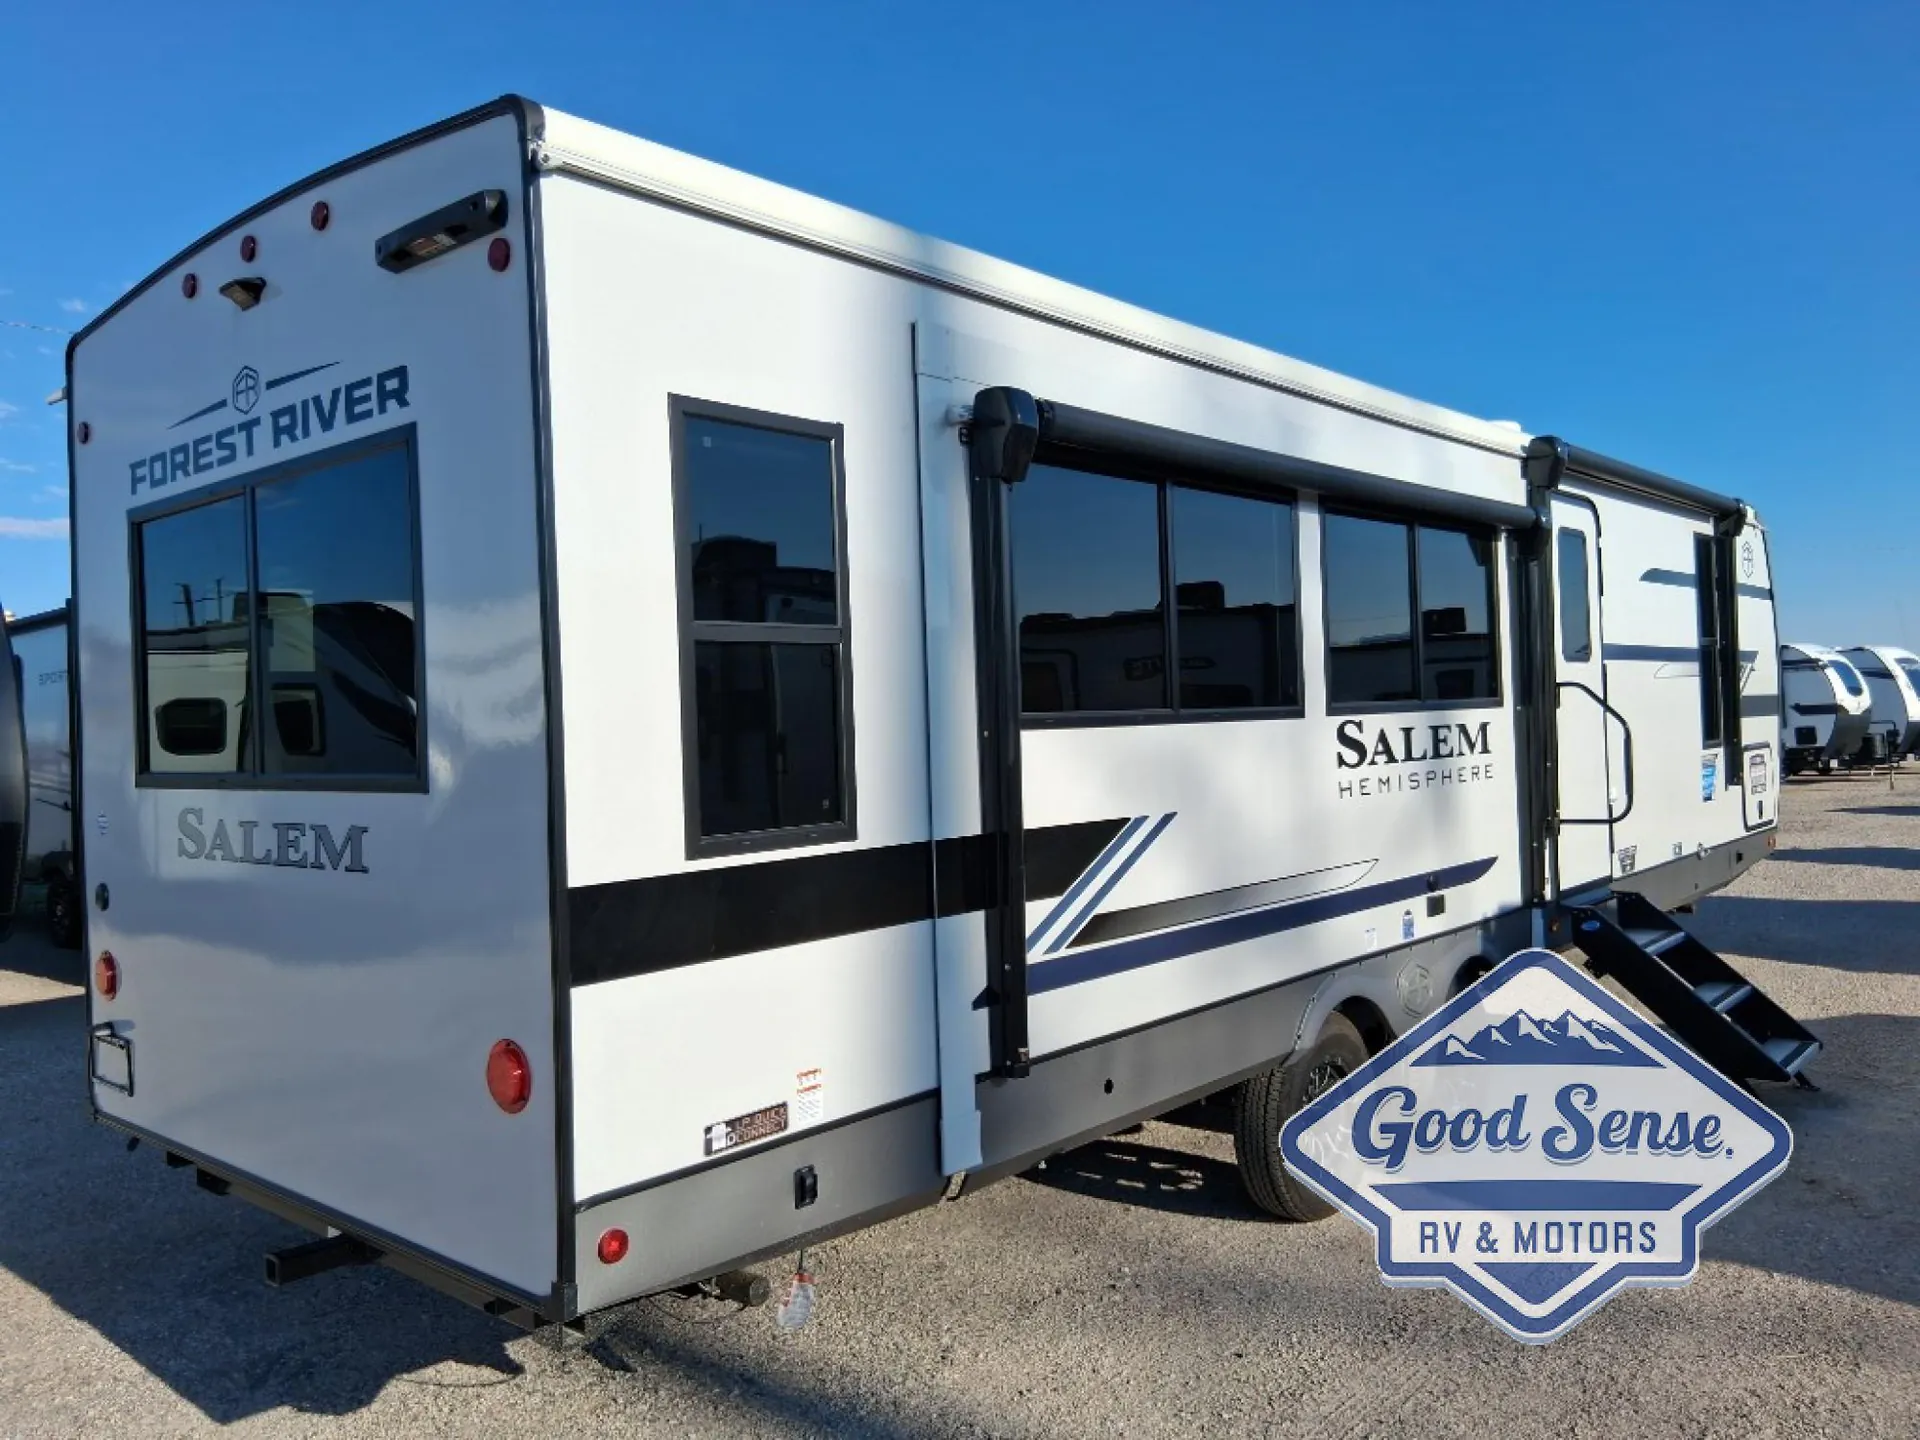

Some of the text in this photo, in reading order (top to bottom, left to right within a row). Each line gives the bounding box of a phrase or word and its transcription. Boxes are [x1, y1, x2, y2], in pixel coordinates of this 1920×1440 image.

[129, 365, 410, 495] FOREST RIVER
[1336, 719, 1492, 769] SALEM
[1338, 763, 1494, 799] HEMISPHERE
[177, 808, 370, 874] SALEM
[736, 1118, 786, 1143] CONNECT
[755, 1106, 787, 1123] QUICK
